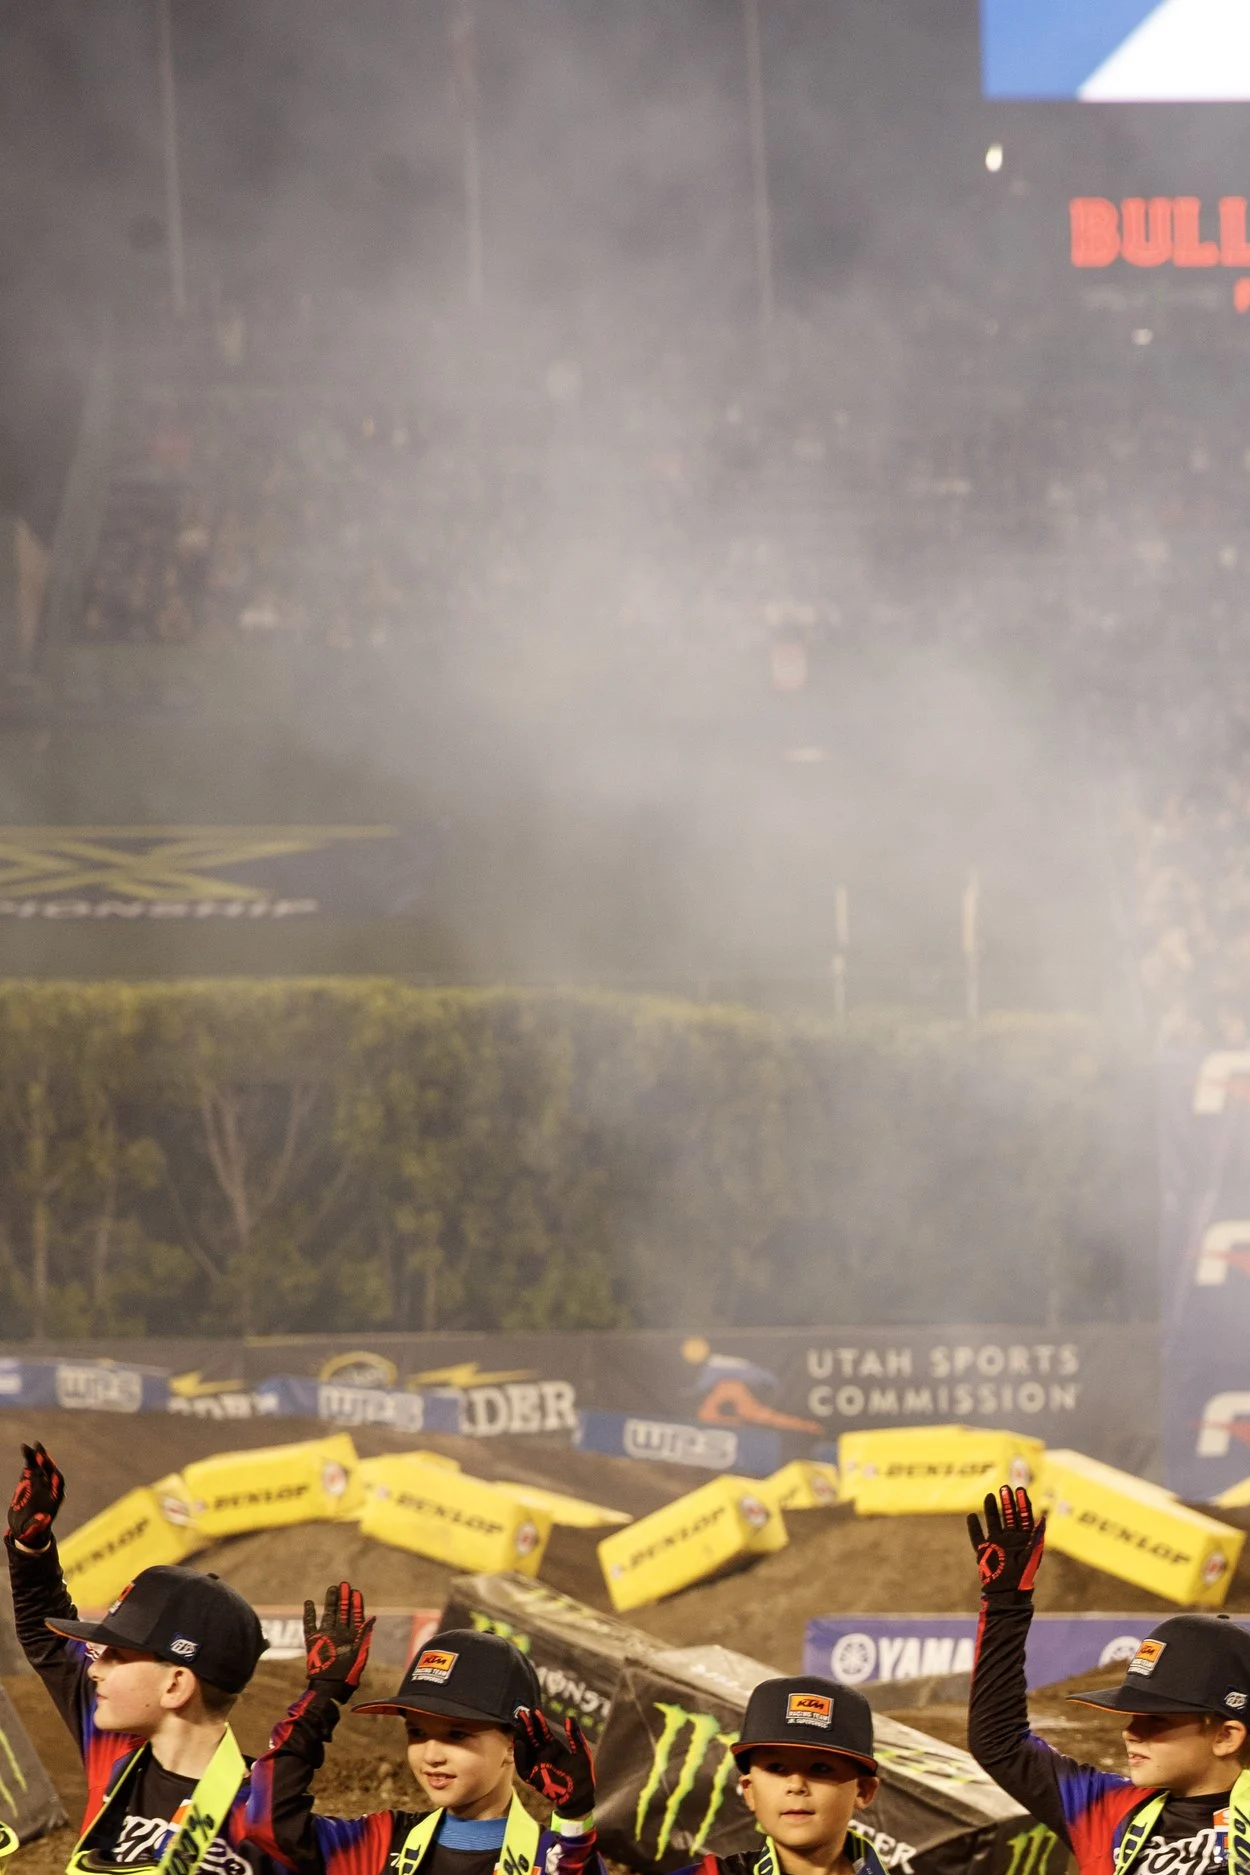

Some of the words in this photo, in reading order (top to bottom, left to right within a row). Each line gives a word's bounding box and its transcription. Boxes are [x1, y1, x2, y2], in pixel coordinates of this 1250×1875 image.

[807, 1347, 912, 1379] UTAH
[931, 1343, 1080, 1377] SPORTS
[807, 1381, 1078, 1418] COMMISSION
[883, 1460, 996, 1478] DUNLOP
[212, 1485, 311, 1512] DUNLOP
[396, 1490, 504, 1536] DUNLOP
[626, 1507, 727, 1567] DUNLOP
[1075, 1509, 1193, 1566] DUNLOP
[423, 1655, 447, 1665] KTM
[796, 1698, 825, 1710] KTM
